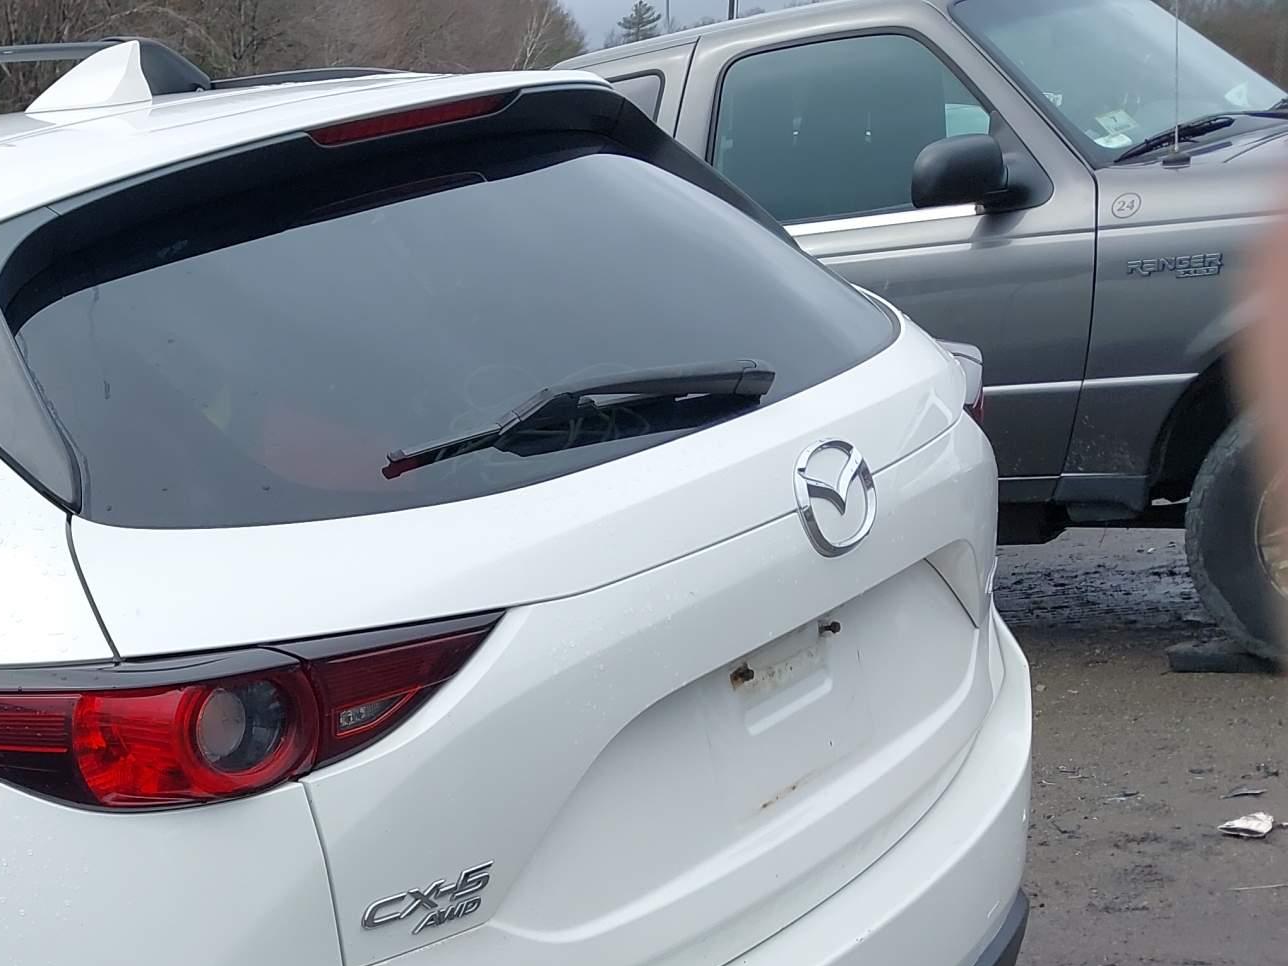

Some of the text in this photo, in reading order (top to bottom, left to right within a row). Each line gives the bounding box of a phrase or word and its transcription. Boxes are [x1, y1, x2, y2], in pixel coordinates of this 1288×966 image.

[1116, 199, 1135, 213] 24
[1126, 252, 1224, 277] RANGER
[361, 859, 495, 930] CX-5
[412, 896, 482, 935] AWD
